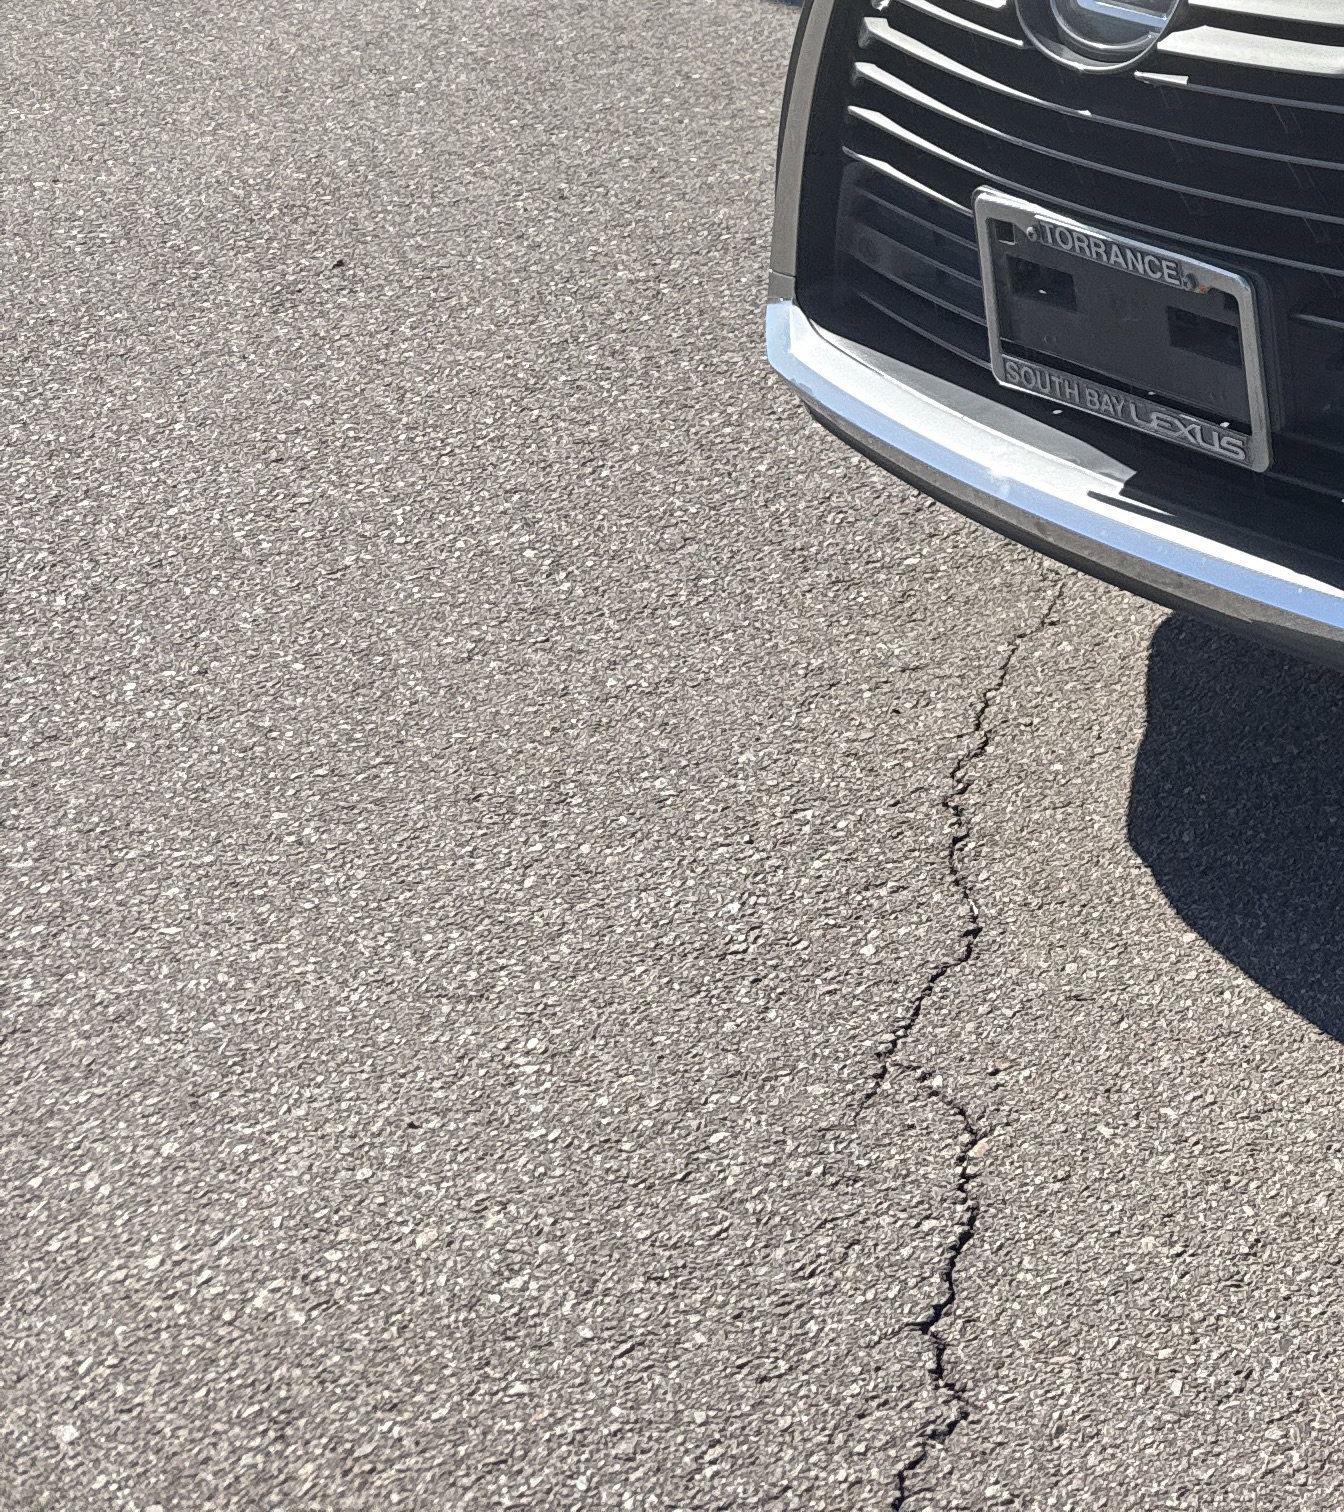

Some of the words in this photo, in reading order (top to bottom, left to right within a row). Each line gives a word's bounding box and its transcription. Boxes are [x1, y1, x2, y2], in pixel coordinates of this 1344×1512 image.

[1044, 222, 1180, 286] TORRANCE
[1005, 360, 1081, 405] SOUTH
[1086, 389, 1127, 419] BAY
[1130, 402, 1246, 461] LEXUS
